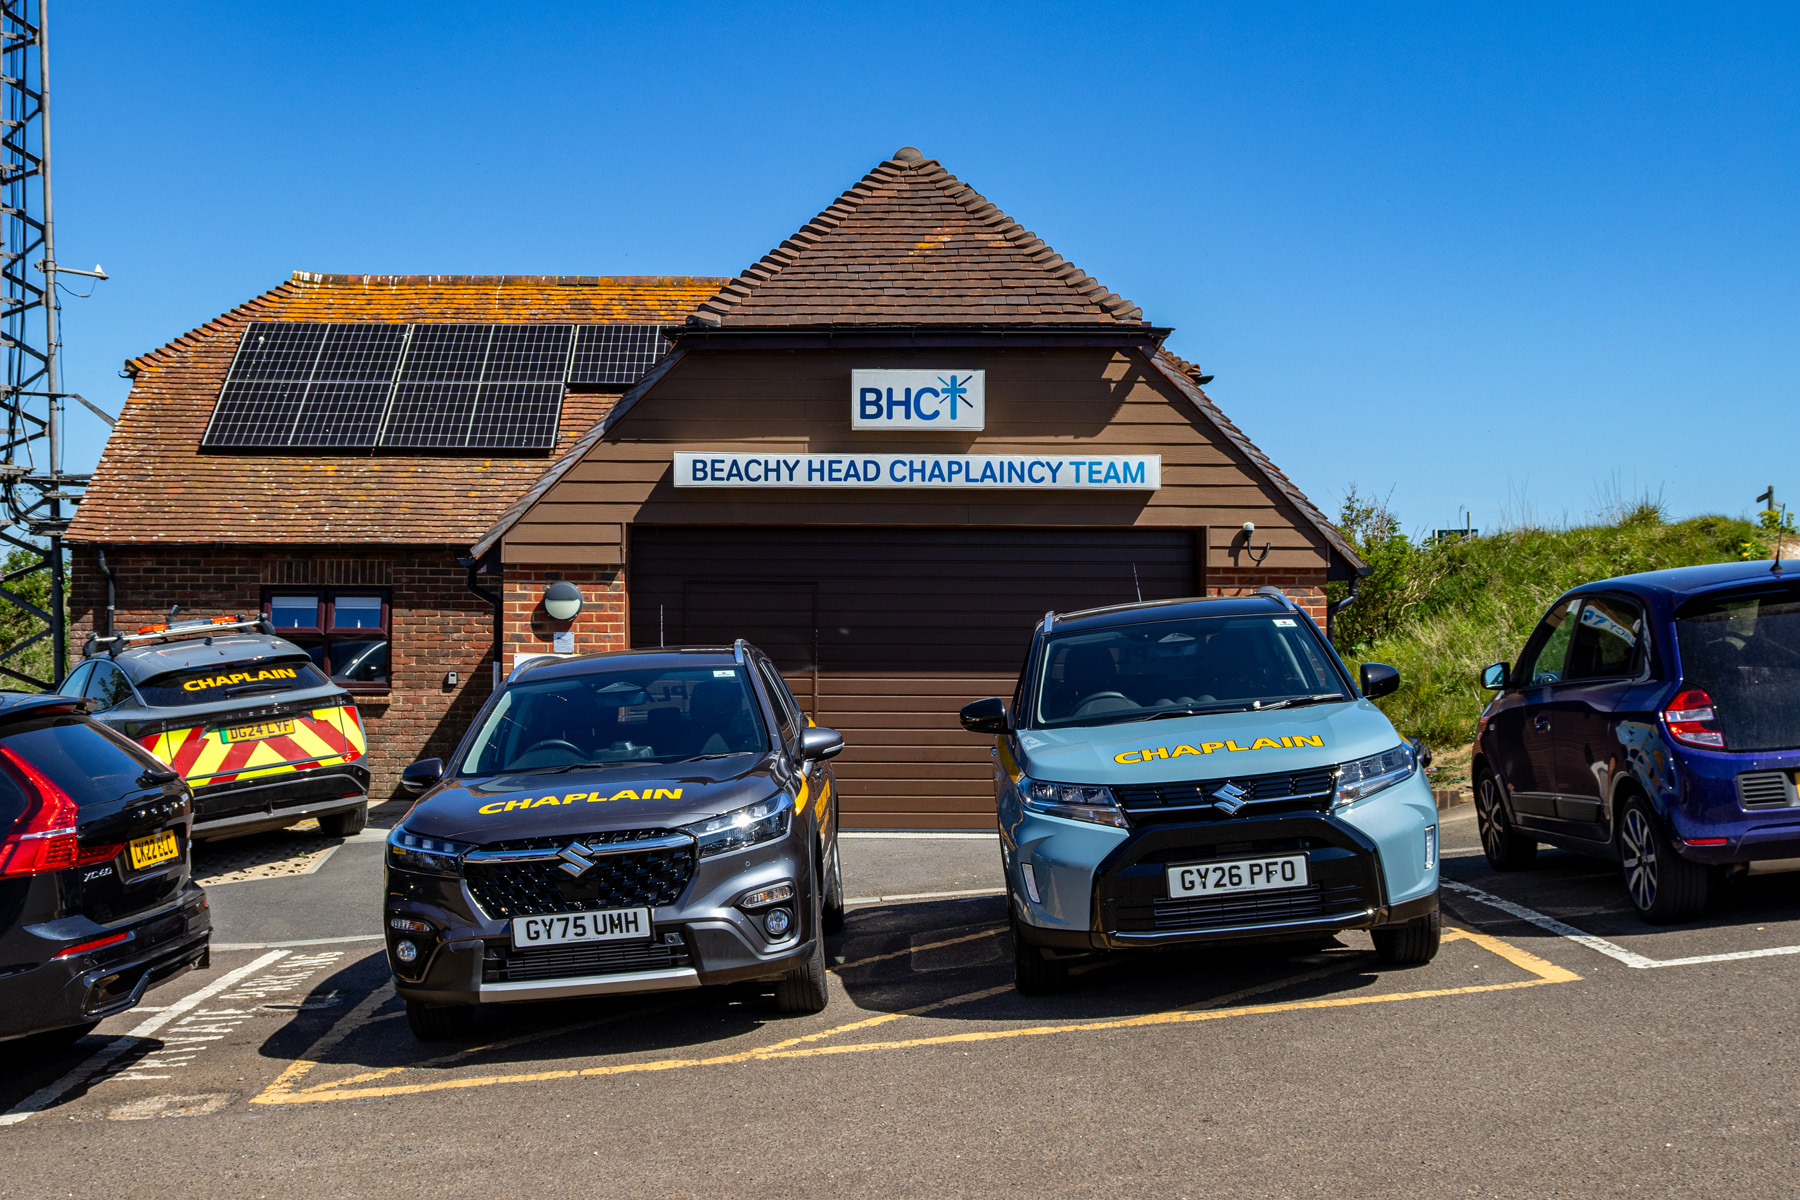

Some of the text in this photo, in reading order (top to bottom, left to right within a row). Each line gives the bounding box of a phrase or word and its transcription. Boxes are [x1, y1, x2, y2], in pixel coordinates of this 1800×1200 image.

[860, 387, 940, 421] BHC
[692, 458, 1145, 483] BEACHY HEAD CHAPLAINCY TEAM
[183, 668, 297, 691] CHAPLAIN
[226, 706, 290, 719] NISSAN
[230, 719, 291, 740] DG24 LYF
[1113, 734, 1325, 765] CHAPLAIN
[478, 788, 683, 815] CHAPLAIN
[83, 866, 112, 882] XC60
[1181, 860, 1295, 891] GY26 PFO
[526, 911, 639, 940] GY75 UMH
